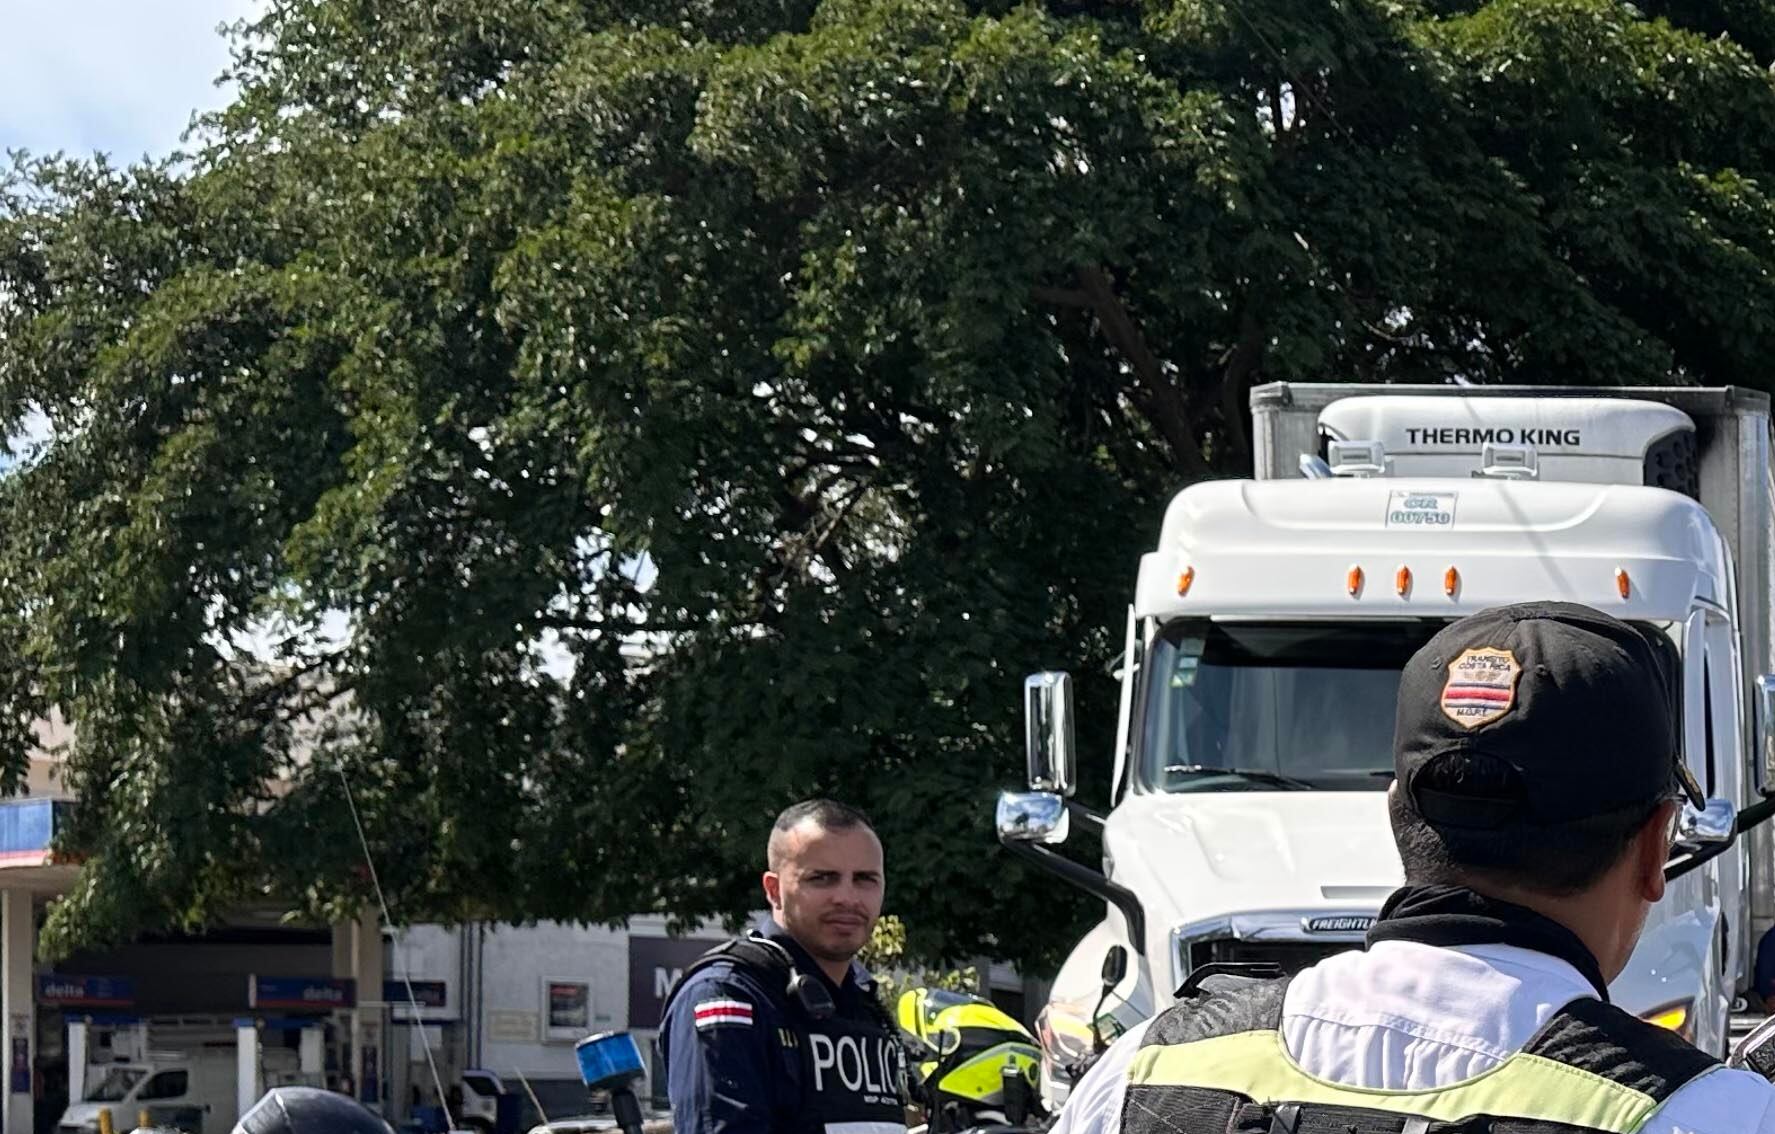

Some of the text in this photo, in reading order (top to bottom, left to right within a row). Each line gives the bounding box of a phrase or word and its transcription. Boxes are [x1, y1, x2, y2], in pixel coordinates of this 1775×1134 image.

[1406, 428, 1581, 446] THERMO KING
[1391, 511, 1451, 525] 00750
[45, 982, 85, 999] delta
[809, 1033, 898, 1095] POLIC
